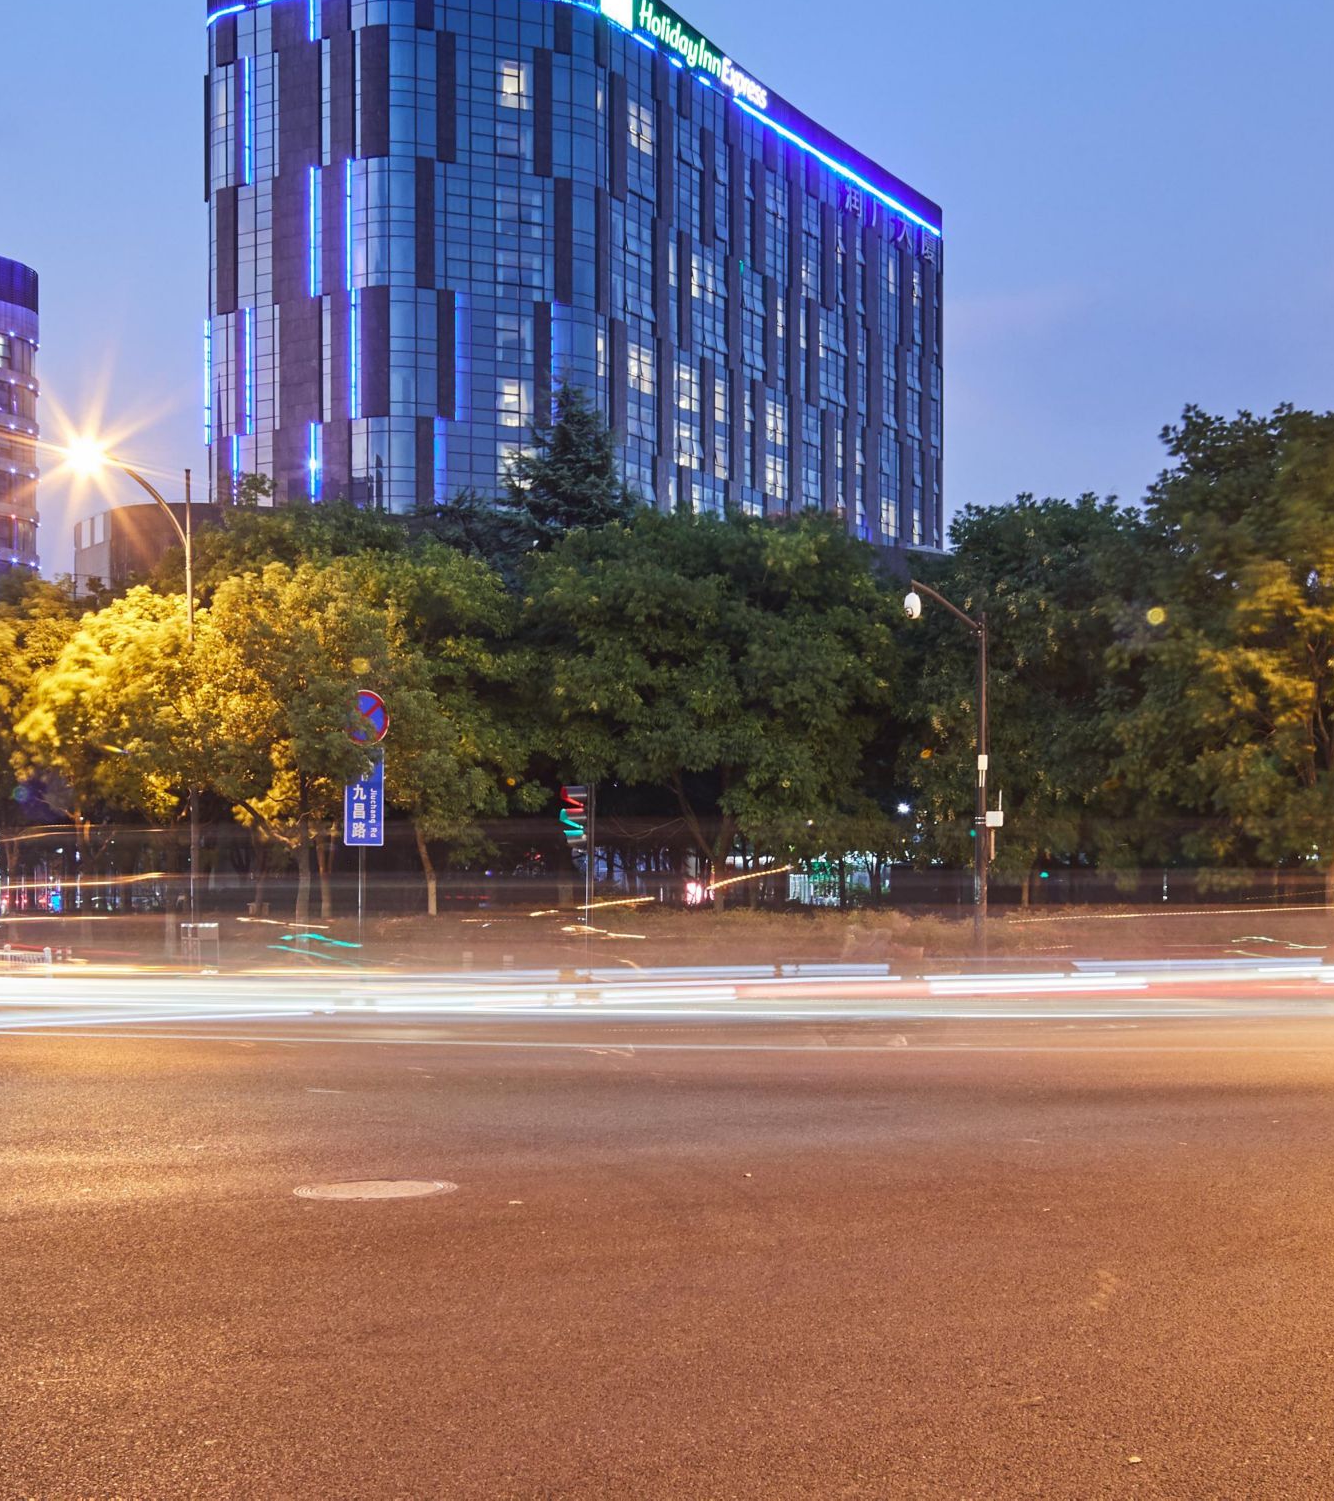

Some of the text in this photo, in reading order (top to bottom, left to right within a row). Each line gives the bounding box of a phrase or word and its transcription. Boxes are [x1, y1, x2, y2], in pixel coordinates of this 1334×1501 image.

[698, 38, 722, 78] Inn
[721, 56, 767, 109] Express
[352, 784, 366, 838] 九昌路
[369, 788, 378, 838] Jiuchang Rd
